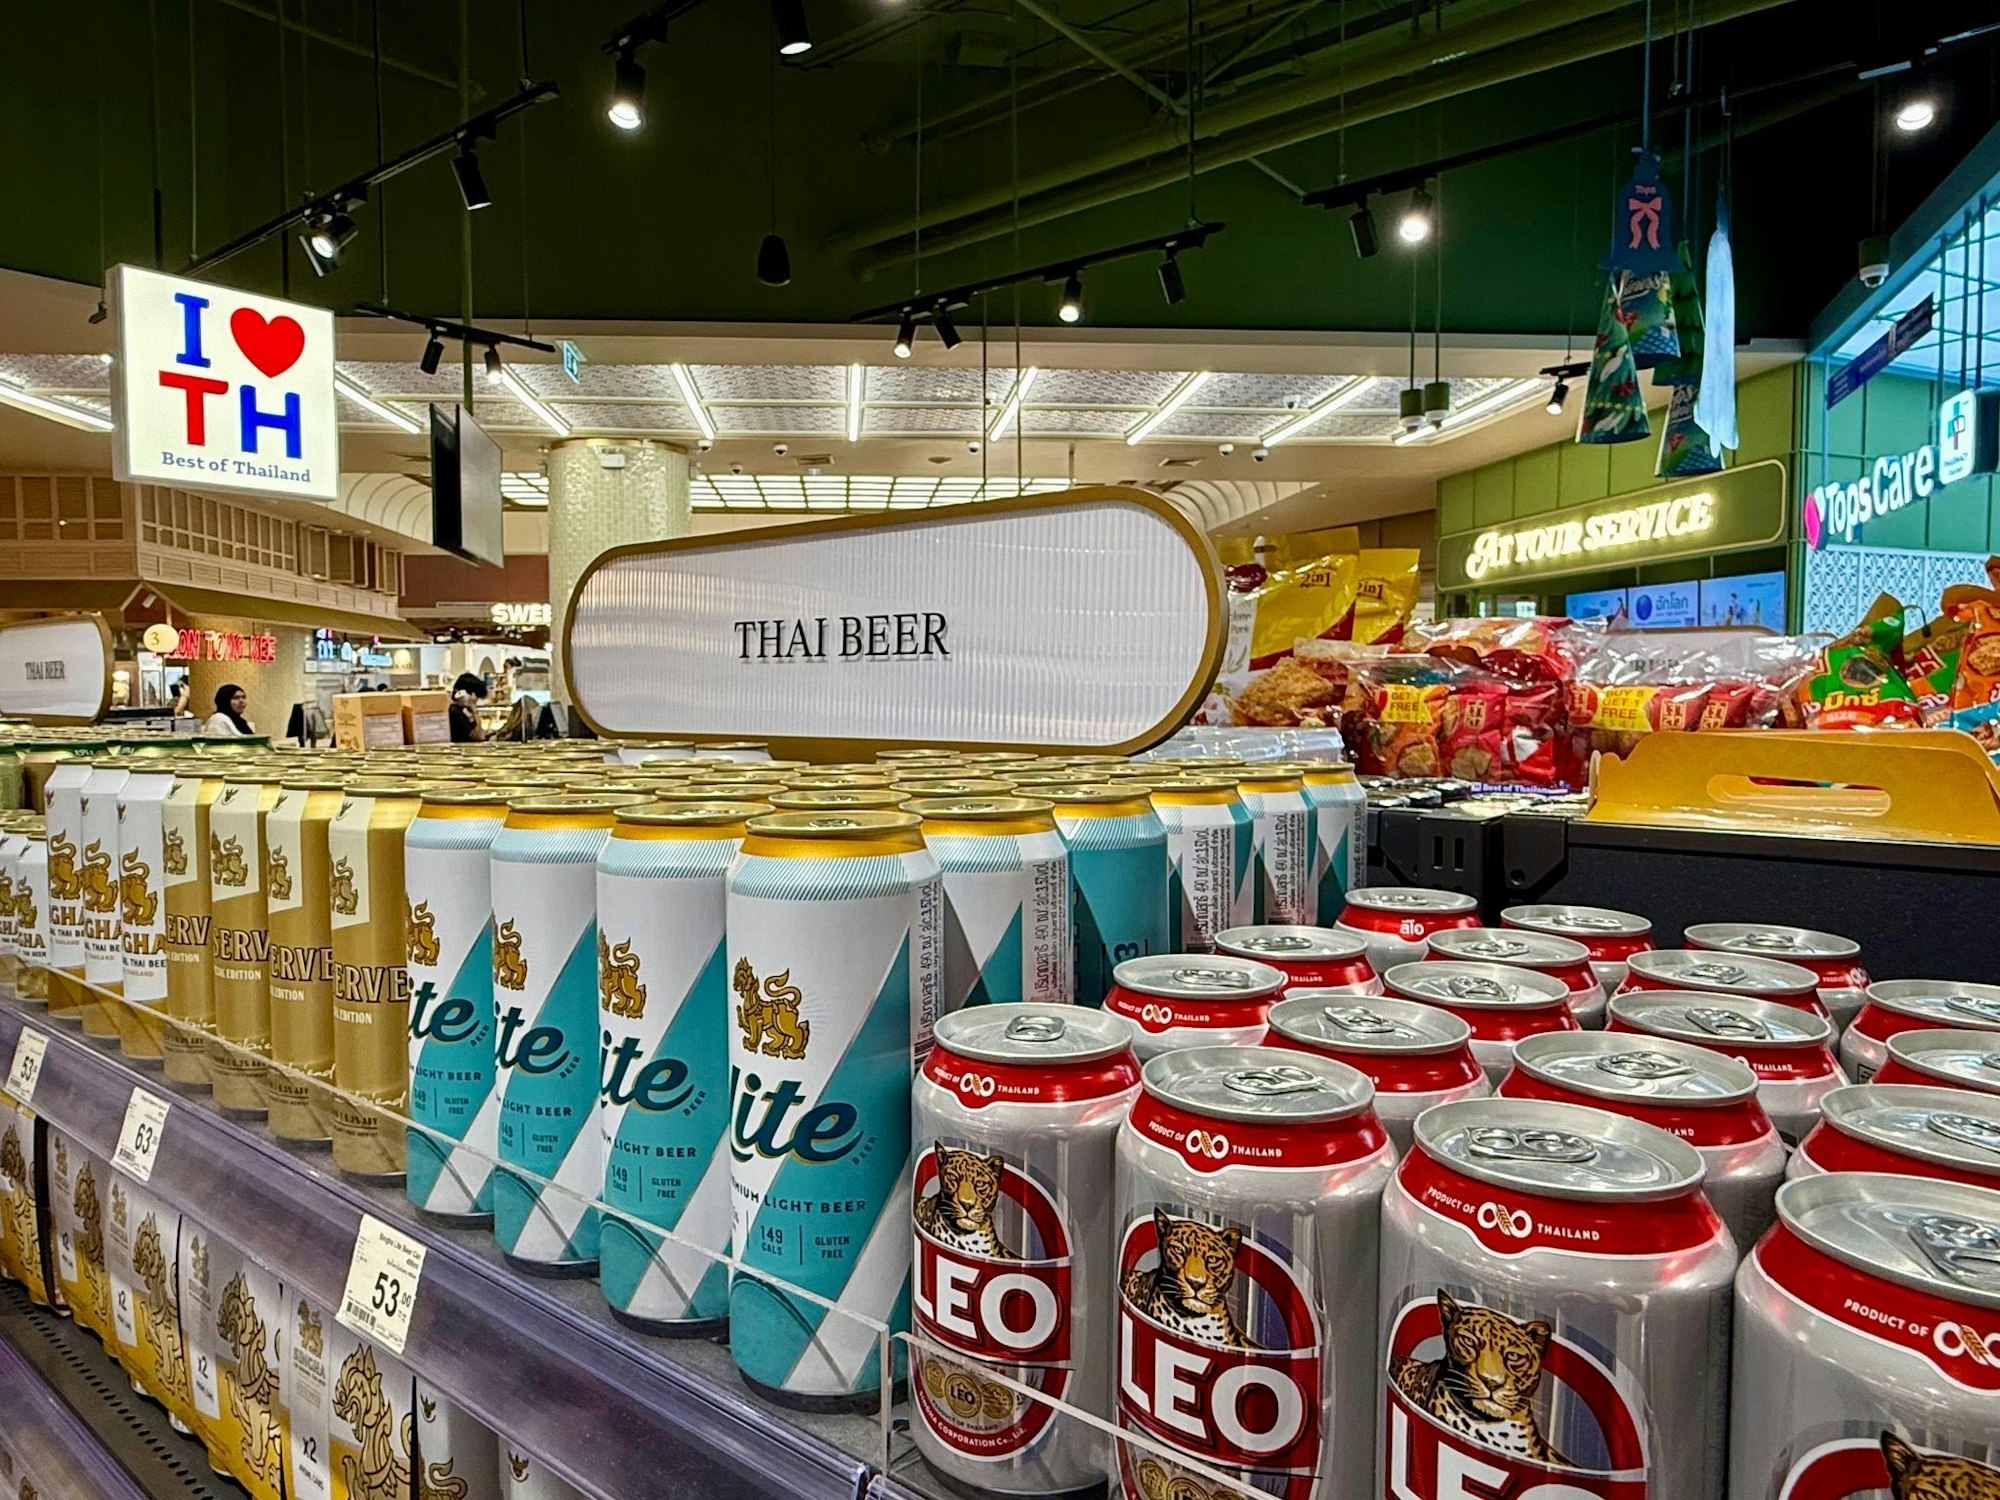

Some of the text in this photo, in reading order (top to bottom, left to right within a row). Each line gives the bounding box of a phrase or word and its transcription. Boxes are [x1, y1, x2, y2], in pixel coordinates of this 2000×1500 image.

[175, 293, 211, 368] I
[162, 452, 311, 482] Best of Thailand
[1513, 521, 1585, 563] YOUR
[1584, 492, 1714, 550] SERVICE
[734, 612, 950, 659] THAI BEER
[25, 660, 65, 680] THAI BEER
[1391, 701, 1419, 711] FREE
[1823, 688, 1880, 711] มิกซ์
[1601, 708, 1638, 719] FREE
[1483, 783, 1502, 792] Best
[1502, 783, 1512, 792] of
[1400, 919, 1425, 936] ลีโอ
[123, 932, 167, 955] GHA
[130, 958, 167, 968] THAI BEE
[270, 944, 333, 981] ERVE
[226, 968, 261, 980] EDITION
[334, 962, 409, 1003] ERVE
[275, 988, 304, 1001] EDITION
[339, 1010, 373, 1024] EDITION
[1174, 1013, 1210, 1022] THAILAND
[471, 1024, 490, 1047] BEER
[20, 1056, 35, 1081] 53
[416, 1066, 482, 1081] LIGHT BEER
[558, 1055, 581, 1079] BEER
[601, 1029, 695, 1111] ite
[1752, 1063, 1793, 1071] THAILAND
[997, 1085, 1040, 1095] THAILAND
[503, 1100, 572, 1117] LIGHT BEER
[683, 1090, 708, 1116] BEER
[135, 1123, 153, 1154] 63
[1149, 1120, 1186, 1142] PRODUCT OF
[536, 1144, 553, 1154] FREE
[614, 1139, 697, 1158] LIGHT BEER
[852, 1136, 878, 1166] BEER
[1232, 1144, 1282, 1157] THAILAND
[612, 1164, 628, 1183] 149
[651, 1176, 681, 1187] GLUTEN
[656, 1188, 676, 1199] FREE
[1427, 1186, 1476, 1215] PRODUCT OF
[764, 1196, 813, 1213] LIGHT
[820, 1200, 867, 1214] BEER
[760, 1225, 783, 1244] 149
[815, 1236, 850, 1247] GLUTEN
[1537, 1223, 1600, 1241] THAILAND
[761, 1244, 783, 1256] CALS
[821, 1249, 844, 1259] FREE
[913, 1234, 1058, 1350] LEO
[1843, 1299, 1929, 1337] PRODUCT OF
[1122, 1311, 1305, 1454] LEO
[950, 1386, 975, 1404] LEO
[919, 1390, 938, 1424] SINGHA
[938, 1421, 996, 1447] CORPORATION
[1391, 1401, 1607, 1500] LE
